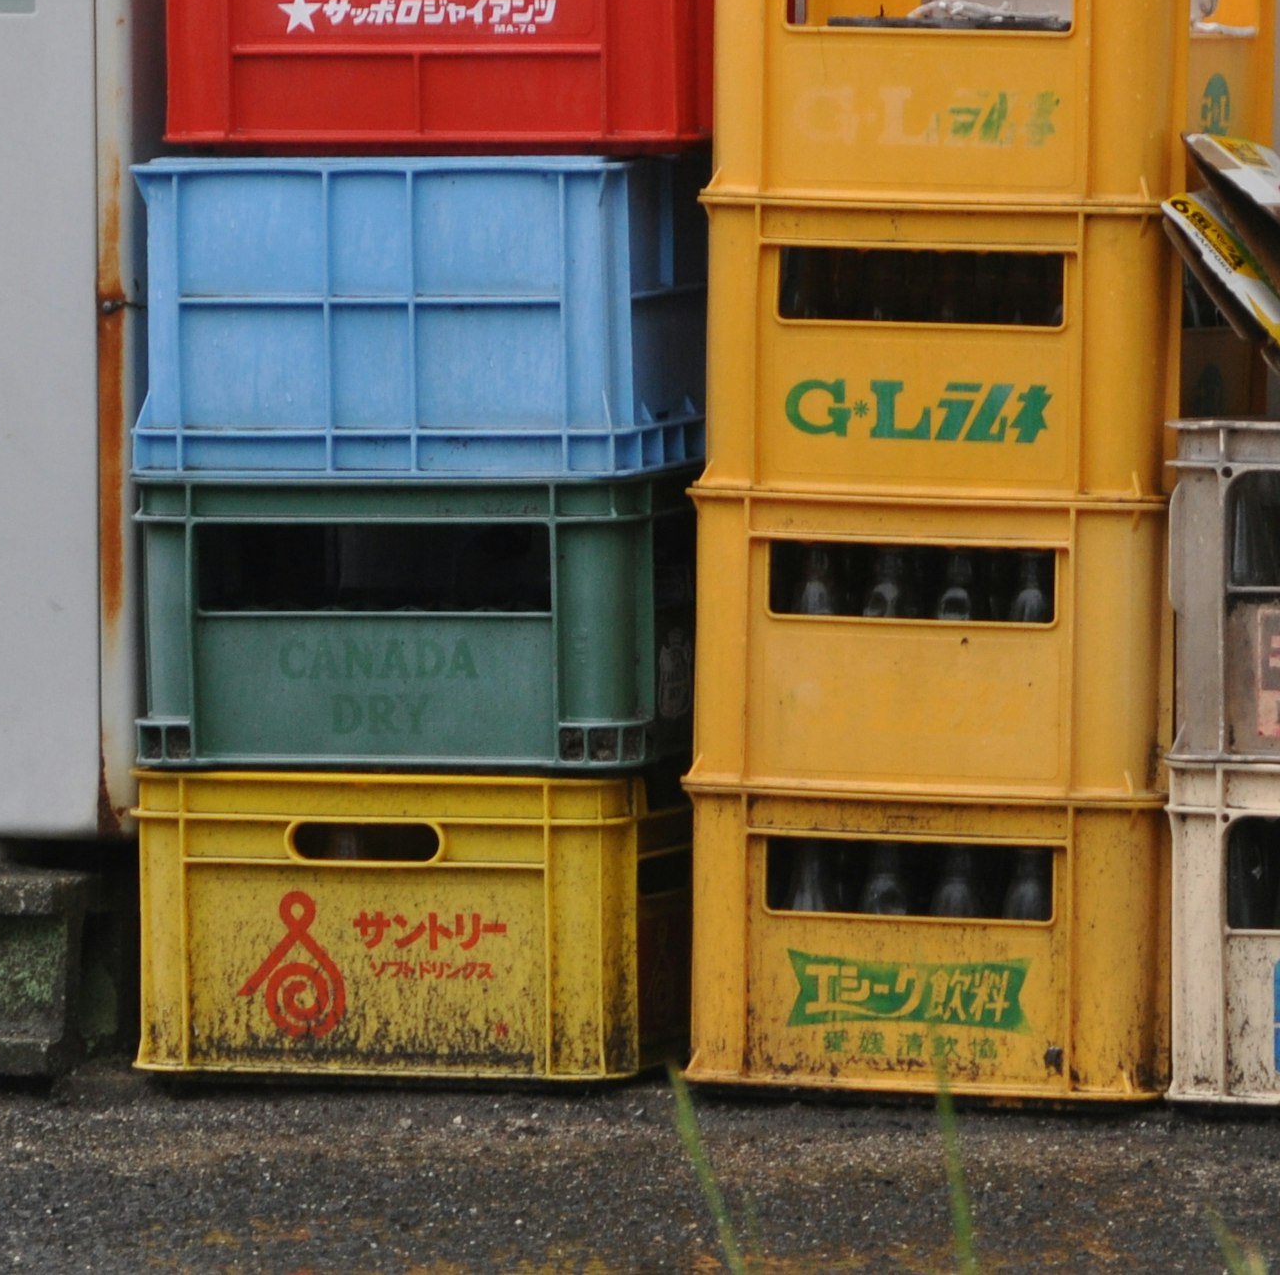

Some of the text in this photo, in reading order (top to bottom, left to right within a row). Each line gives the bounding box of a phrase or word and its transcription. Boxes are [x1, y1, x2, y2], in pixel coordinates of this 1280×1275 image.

[494, 24, 537, 34] MA-78
[278, 637, 480, 679] CANADA
[330, 693, 433, 736] DRY
[353, 911, 508, 950] サントリー
[370, 960, 495, 980] ソフトドリンクス
